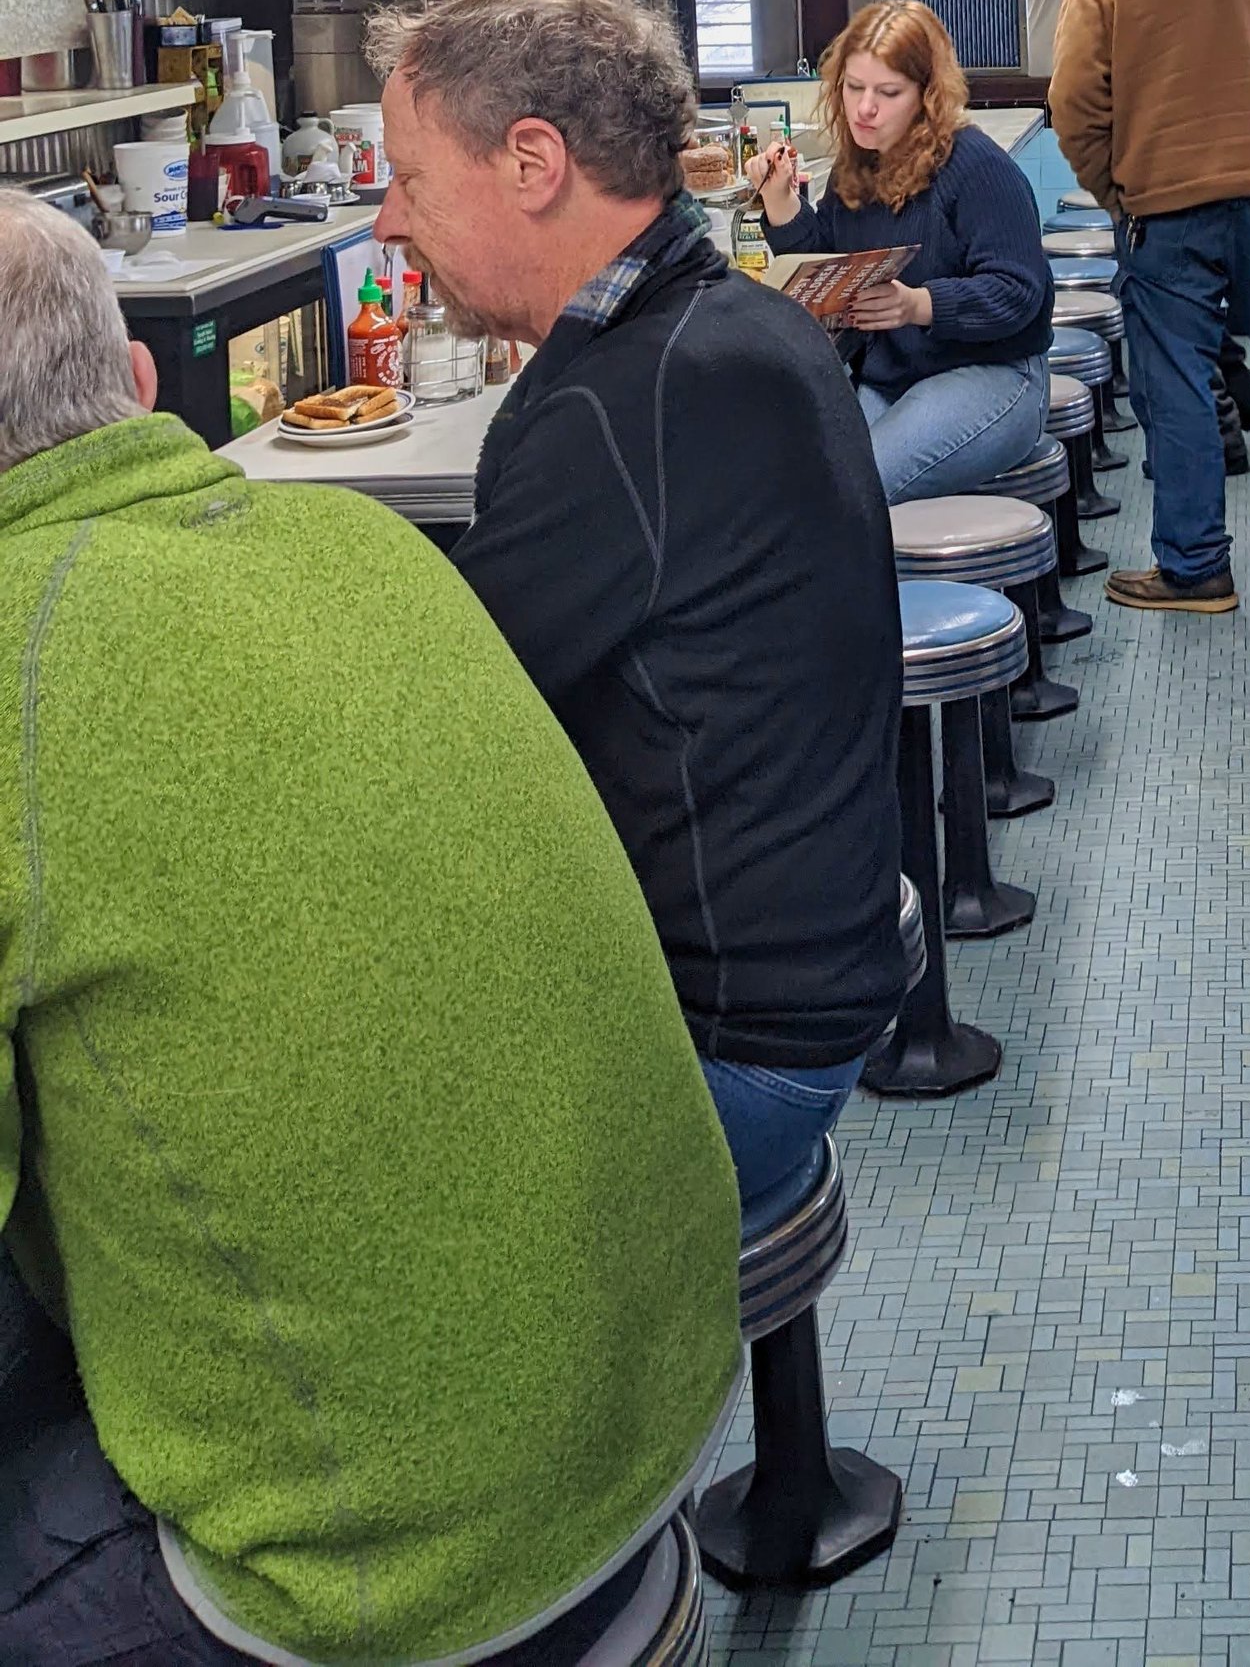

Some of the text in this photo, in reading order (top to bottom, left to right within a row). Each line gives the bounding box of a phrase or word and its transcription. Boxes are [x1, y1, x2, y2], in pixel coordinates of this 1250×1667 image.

[154, 192, 179, 203] Sour
[798, 264, 838, 307] HILDREN
[812, 264, 852, 302] ARCHIVE
[837, 262, 877, 299] VALERIA
